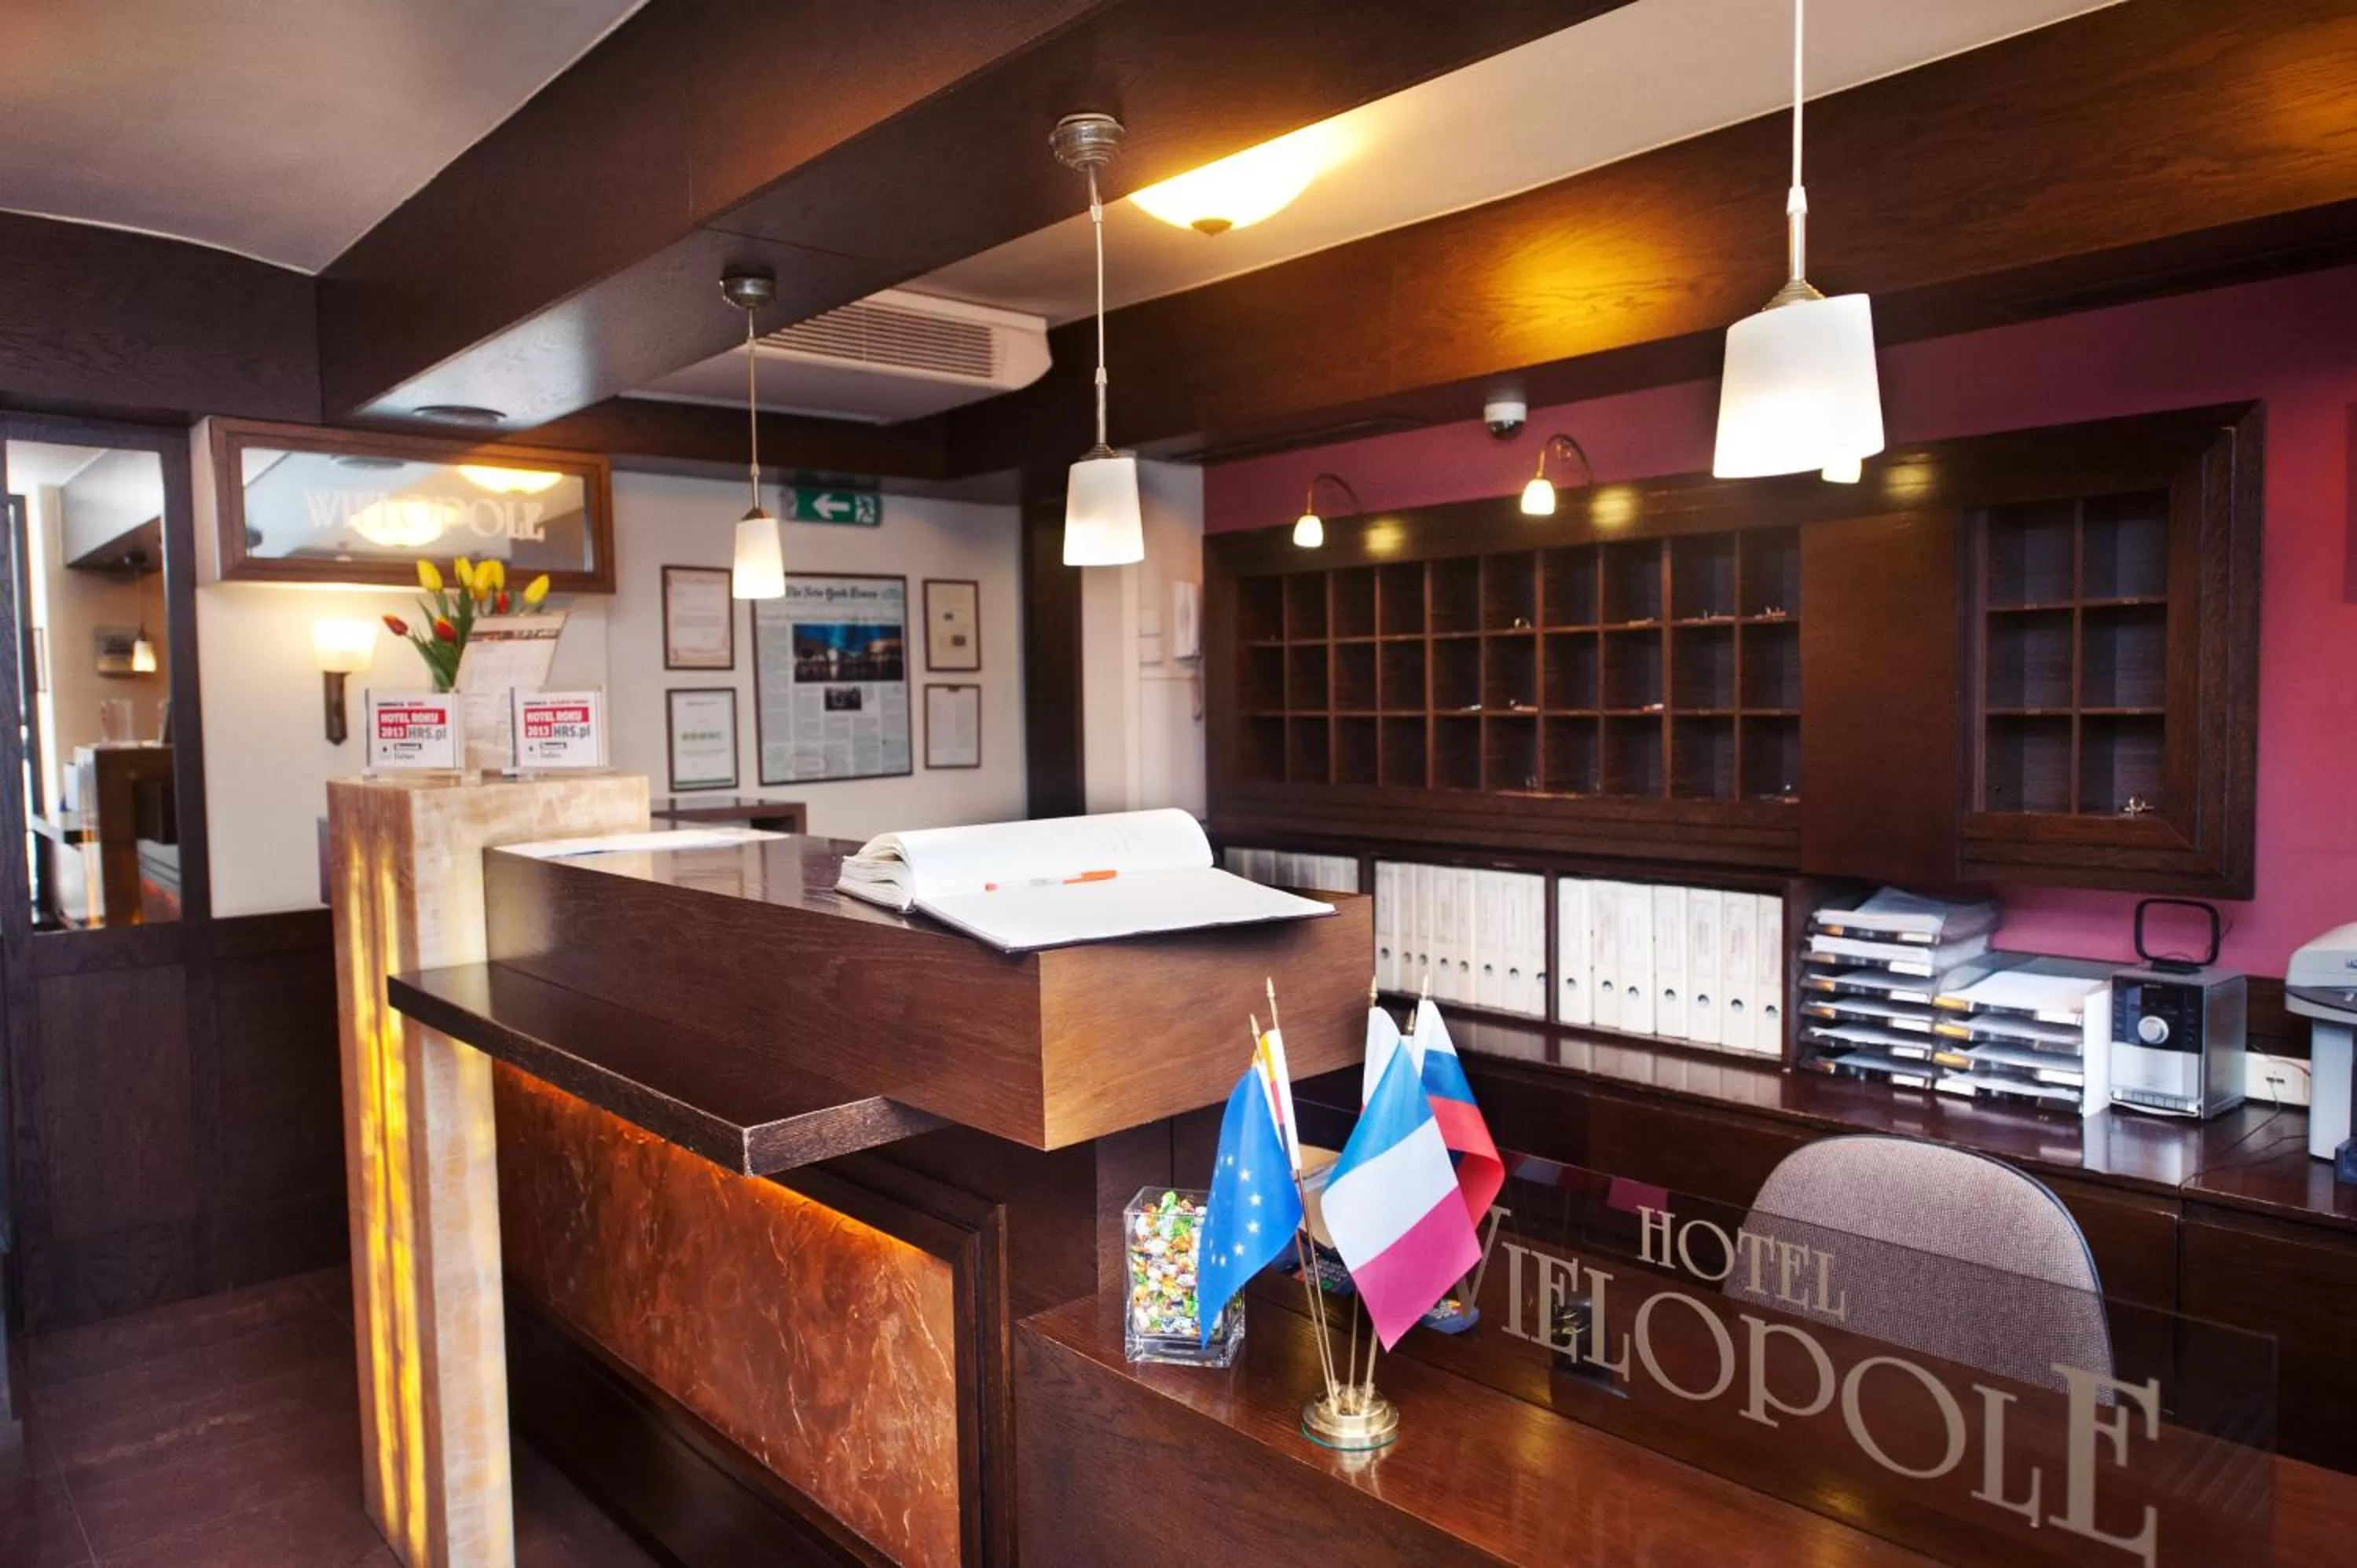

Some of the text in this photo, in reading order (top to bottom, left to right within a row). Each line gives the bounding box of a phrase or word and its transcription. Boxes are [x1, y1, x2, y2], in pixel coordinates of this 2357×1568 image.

[380, 712, 410, 724] HOTEL
[526, 711, 555, 723] HOTEL
[408, 727, 447, 741] HRS.pl
[553, 724, 591, 740] HRS.pl
[1636, 1205, 1846, 1321] HOTEL
